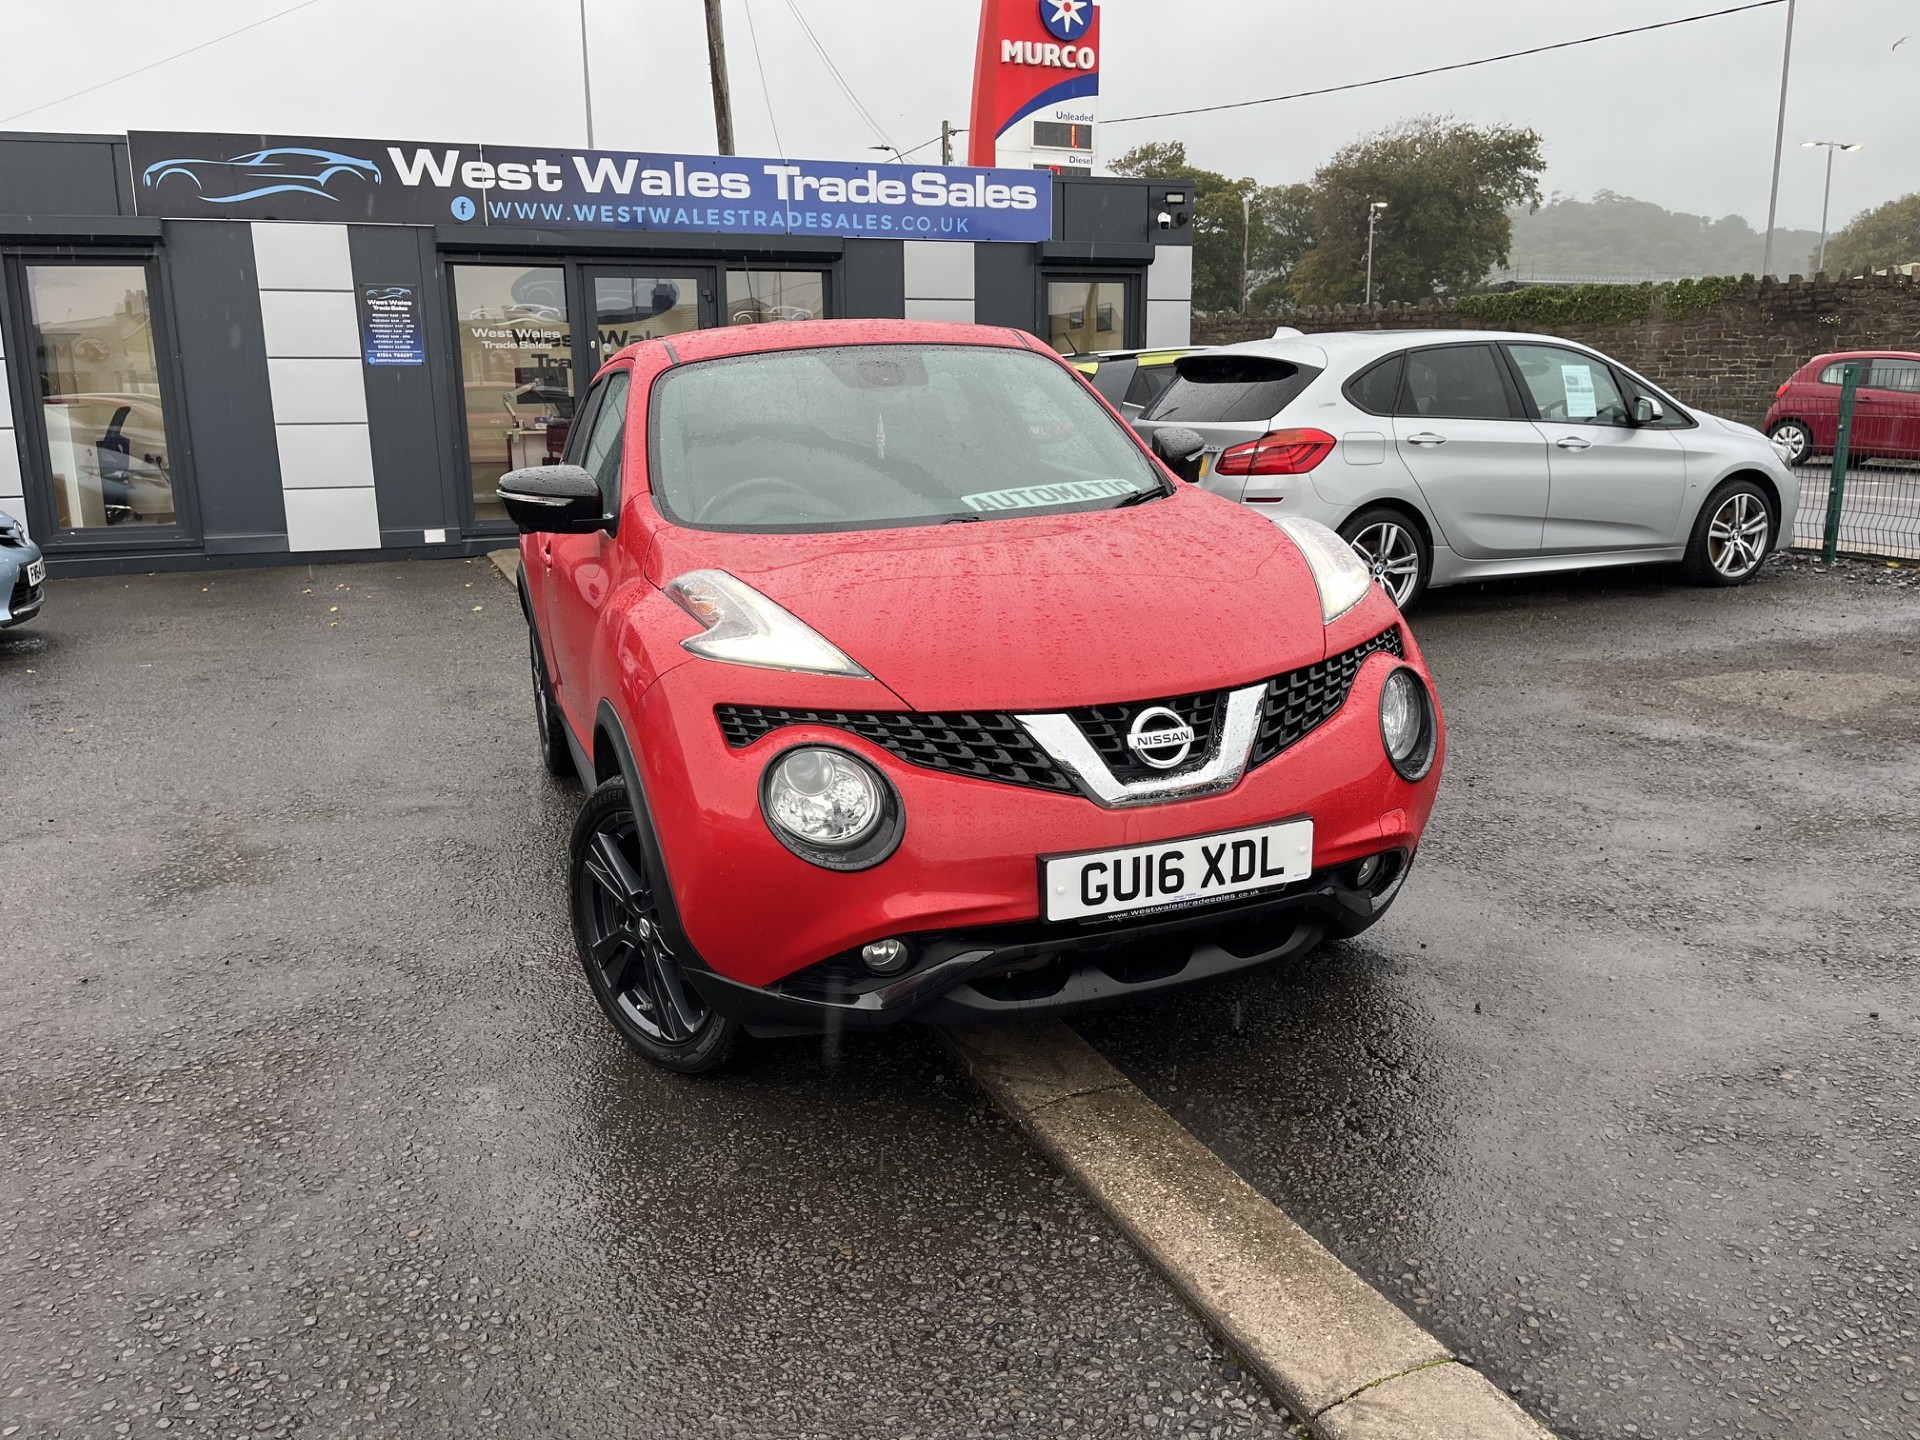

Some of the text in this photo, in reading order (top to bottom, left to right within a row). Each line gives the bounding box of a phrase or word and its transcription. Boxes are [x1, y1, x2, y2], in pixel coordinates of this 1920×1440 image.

[1001, 39, 1095, 70] MURCO
[1056, 111, 1093, 122] Unleaded
[1069, 155, 1093, 165] Diesel
[387, 147, 1038, 210] West Wales Trade Sales
[488, 201, 969, 233] WWW.WESTWALESTRADESALES.CO.UK
[471, 328, 561, 338] West Wales
[482, 340, 553, 349] Trade Sales
[1137, 731, 1189, 746] NISSAN
[1080, 835, 1285, 906] GU16 XDL
